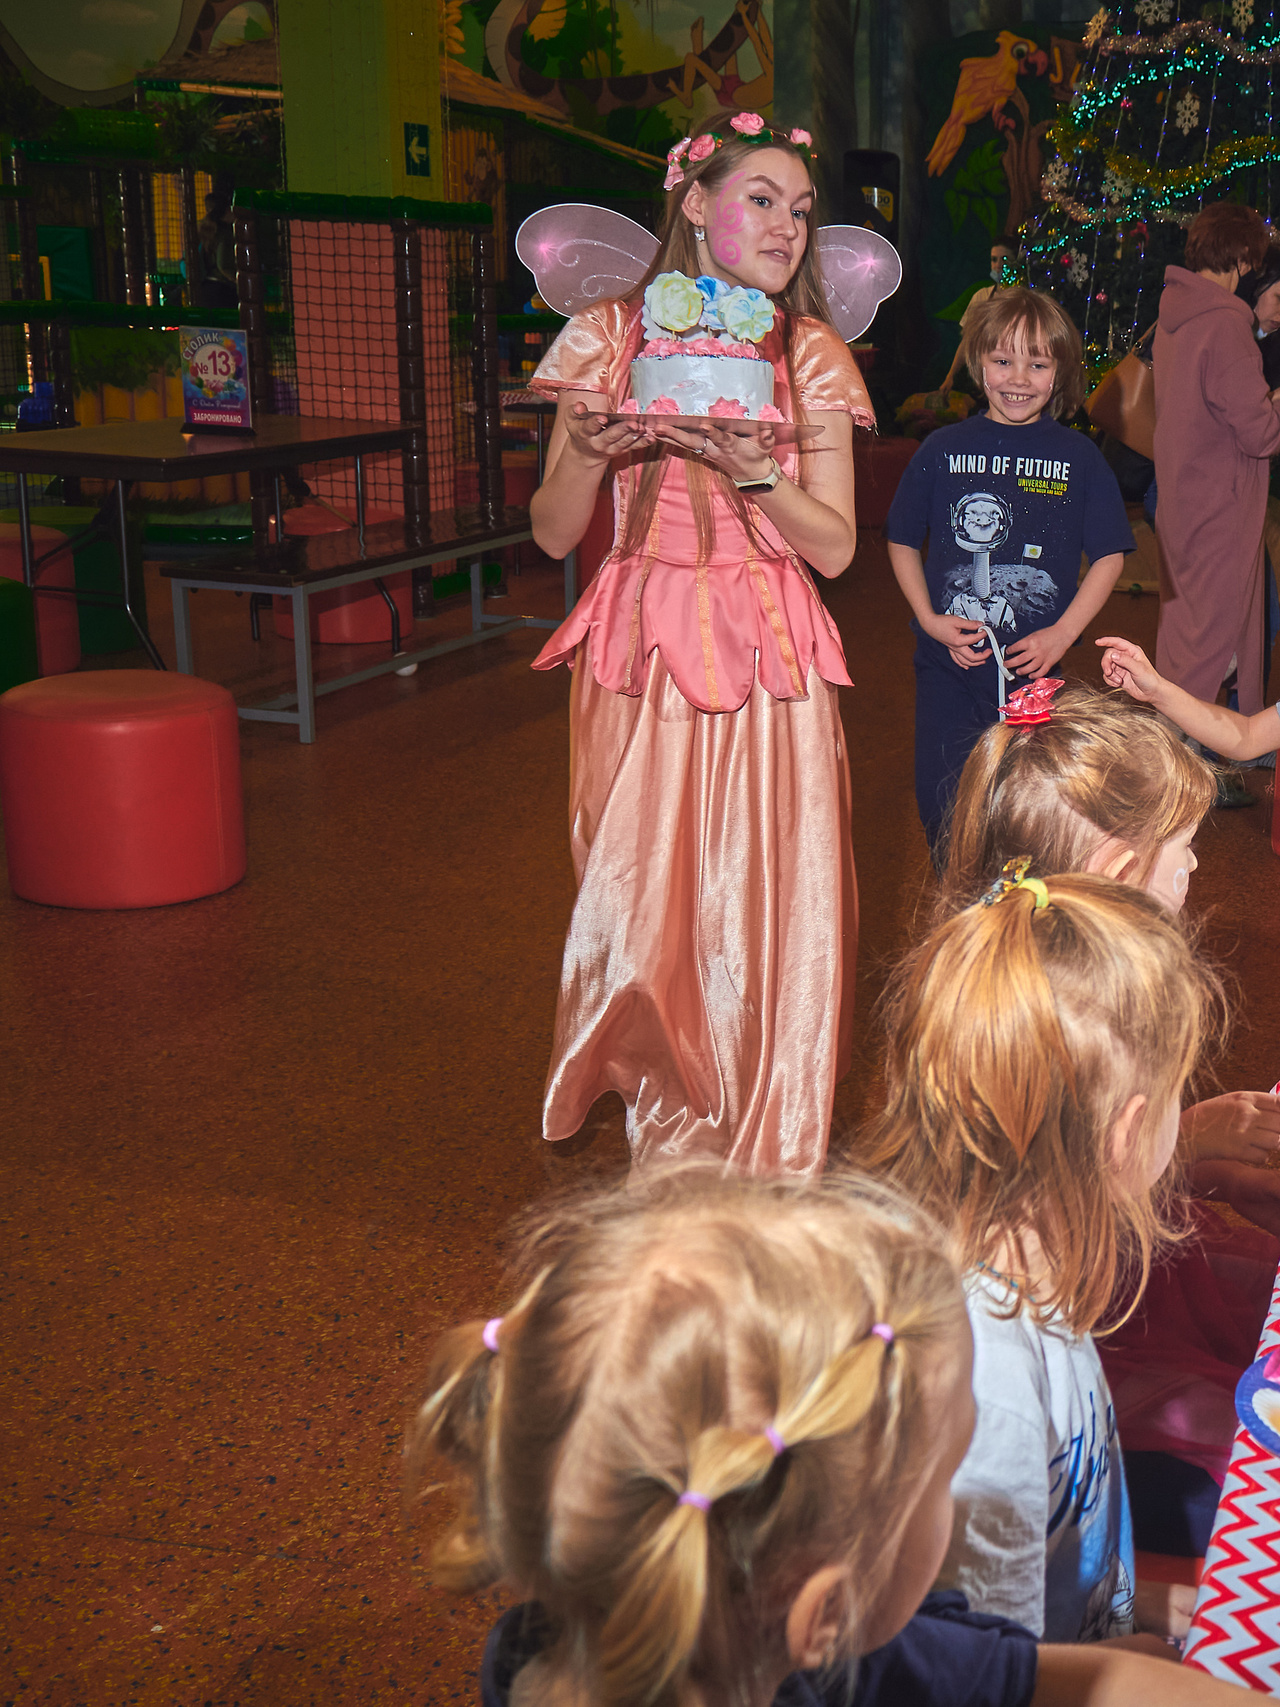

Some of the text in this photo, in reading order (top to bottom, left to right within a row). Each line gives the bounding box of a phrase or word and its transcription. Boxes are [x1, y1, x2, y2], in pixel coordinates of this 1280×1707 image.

[183, 332, 219, 360] СТОЛИК
[208, 350, 231, 376] 13
[193, 413, 242, 423] ЗАБРОНИРОВАНО
[950, 454, 1071, 481] MIND OF FUTURE
[1018, 478, 1068, 492] UNIVERSAL TOURS
